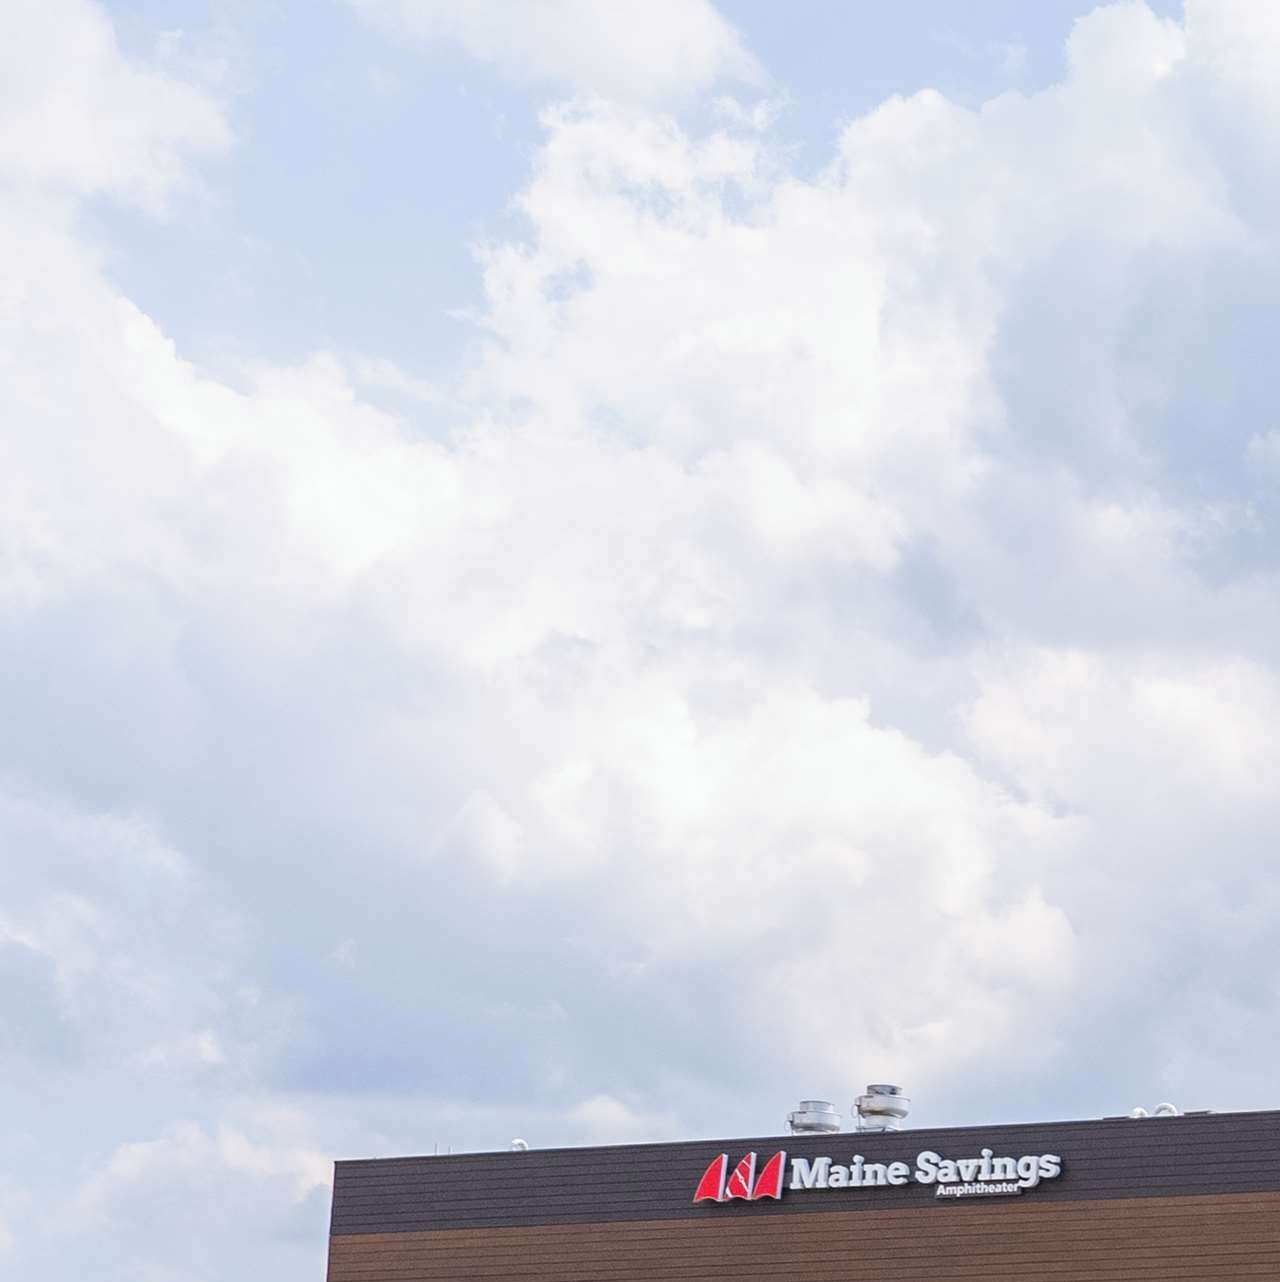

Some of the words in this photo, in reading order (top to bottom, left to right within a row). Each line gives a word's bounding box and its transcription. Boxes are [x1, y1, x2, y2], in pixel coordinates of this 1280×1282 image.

[790, 1154, 910, 1190] Maine
[914, 1148, 1061, 1187] Savings
[936, 1181, 1020, 1197] Amphitheater
